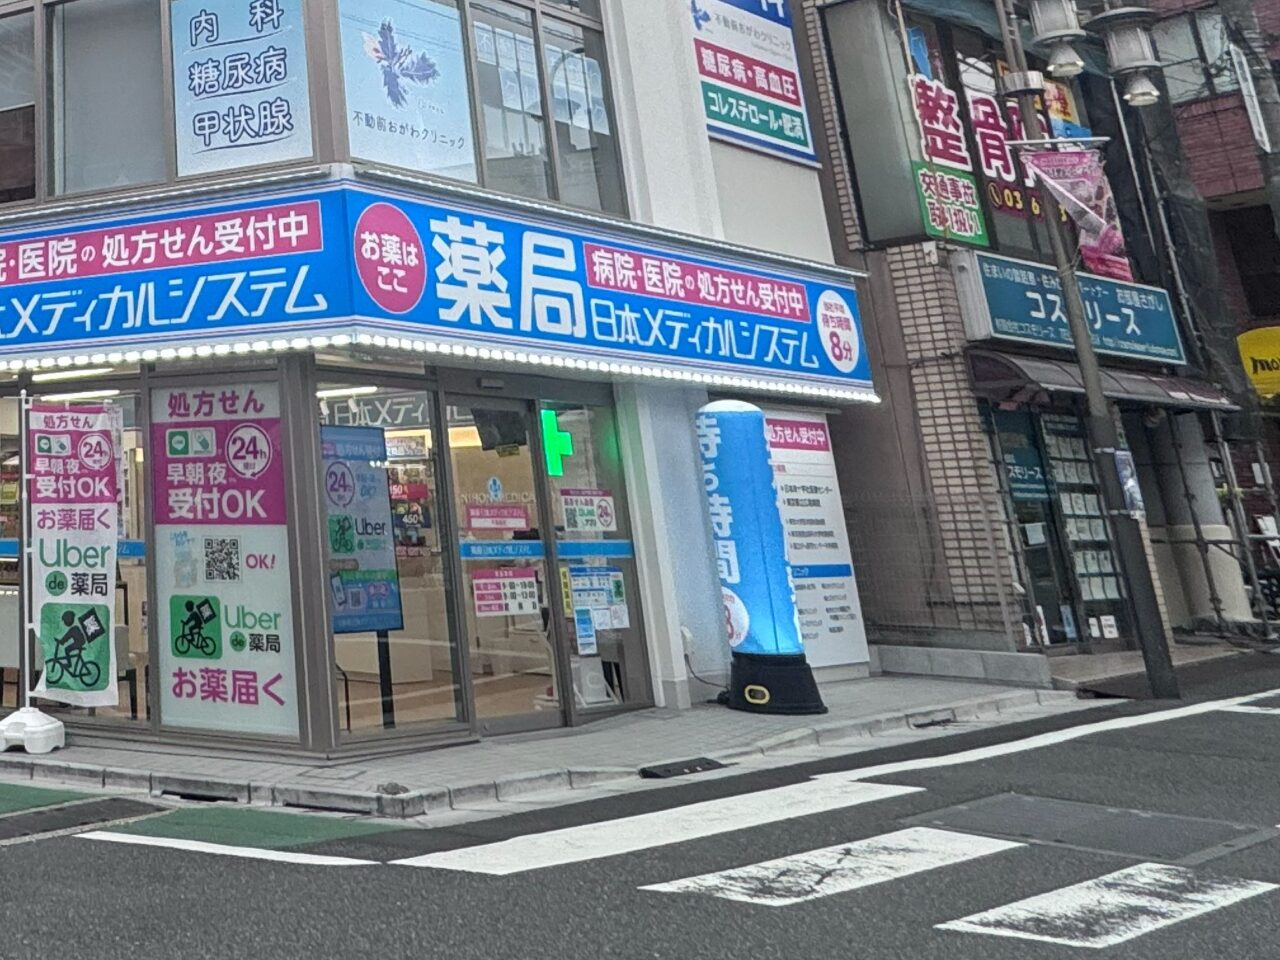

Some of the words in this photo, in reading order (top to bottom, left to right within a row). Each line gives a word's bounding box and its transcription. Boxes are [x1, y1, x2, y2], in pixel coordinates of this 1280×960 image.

[188, 46, 288, 96] 糖尿病
[700, 46, 798, 100] 糖尿病・高血圧
[193, 97, 293, 147] 甲状腺
[352, 109, 466, 150] 不動前おがわクリニック
[360, 229, 419, 269] お薬は
[377, 265, 408, 295] ここ
[430, 216, 587, 338] 薬局
[591, 248, 804, 317] 病院・医院の処方せん受付中
[1026, 290, 1142, 336] コスリース
[590, 297, 820, 369] 日本メディカルシステム
[829, 331, 853, 362] 8分
[167, 388, 265, 418] 処方せん
[44, 415, 93, 429] 処方せん
[36, 476, 112, 499] 受付OK
[167, 487, 268, 520] 受付OK
[37, 508, 111, 531] お薬届く
[355, 518, 387, 536] Uber
[39, 539, 111, 569] Uber
[245, 553, 277, 569] OK!
[71, 572, 108, 596] 薬局
[224, 604, 282, 631] Uber
[249, 633, 281, 654] 薬局
[172, 666, 286, 707] お薬届く
